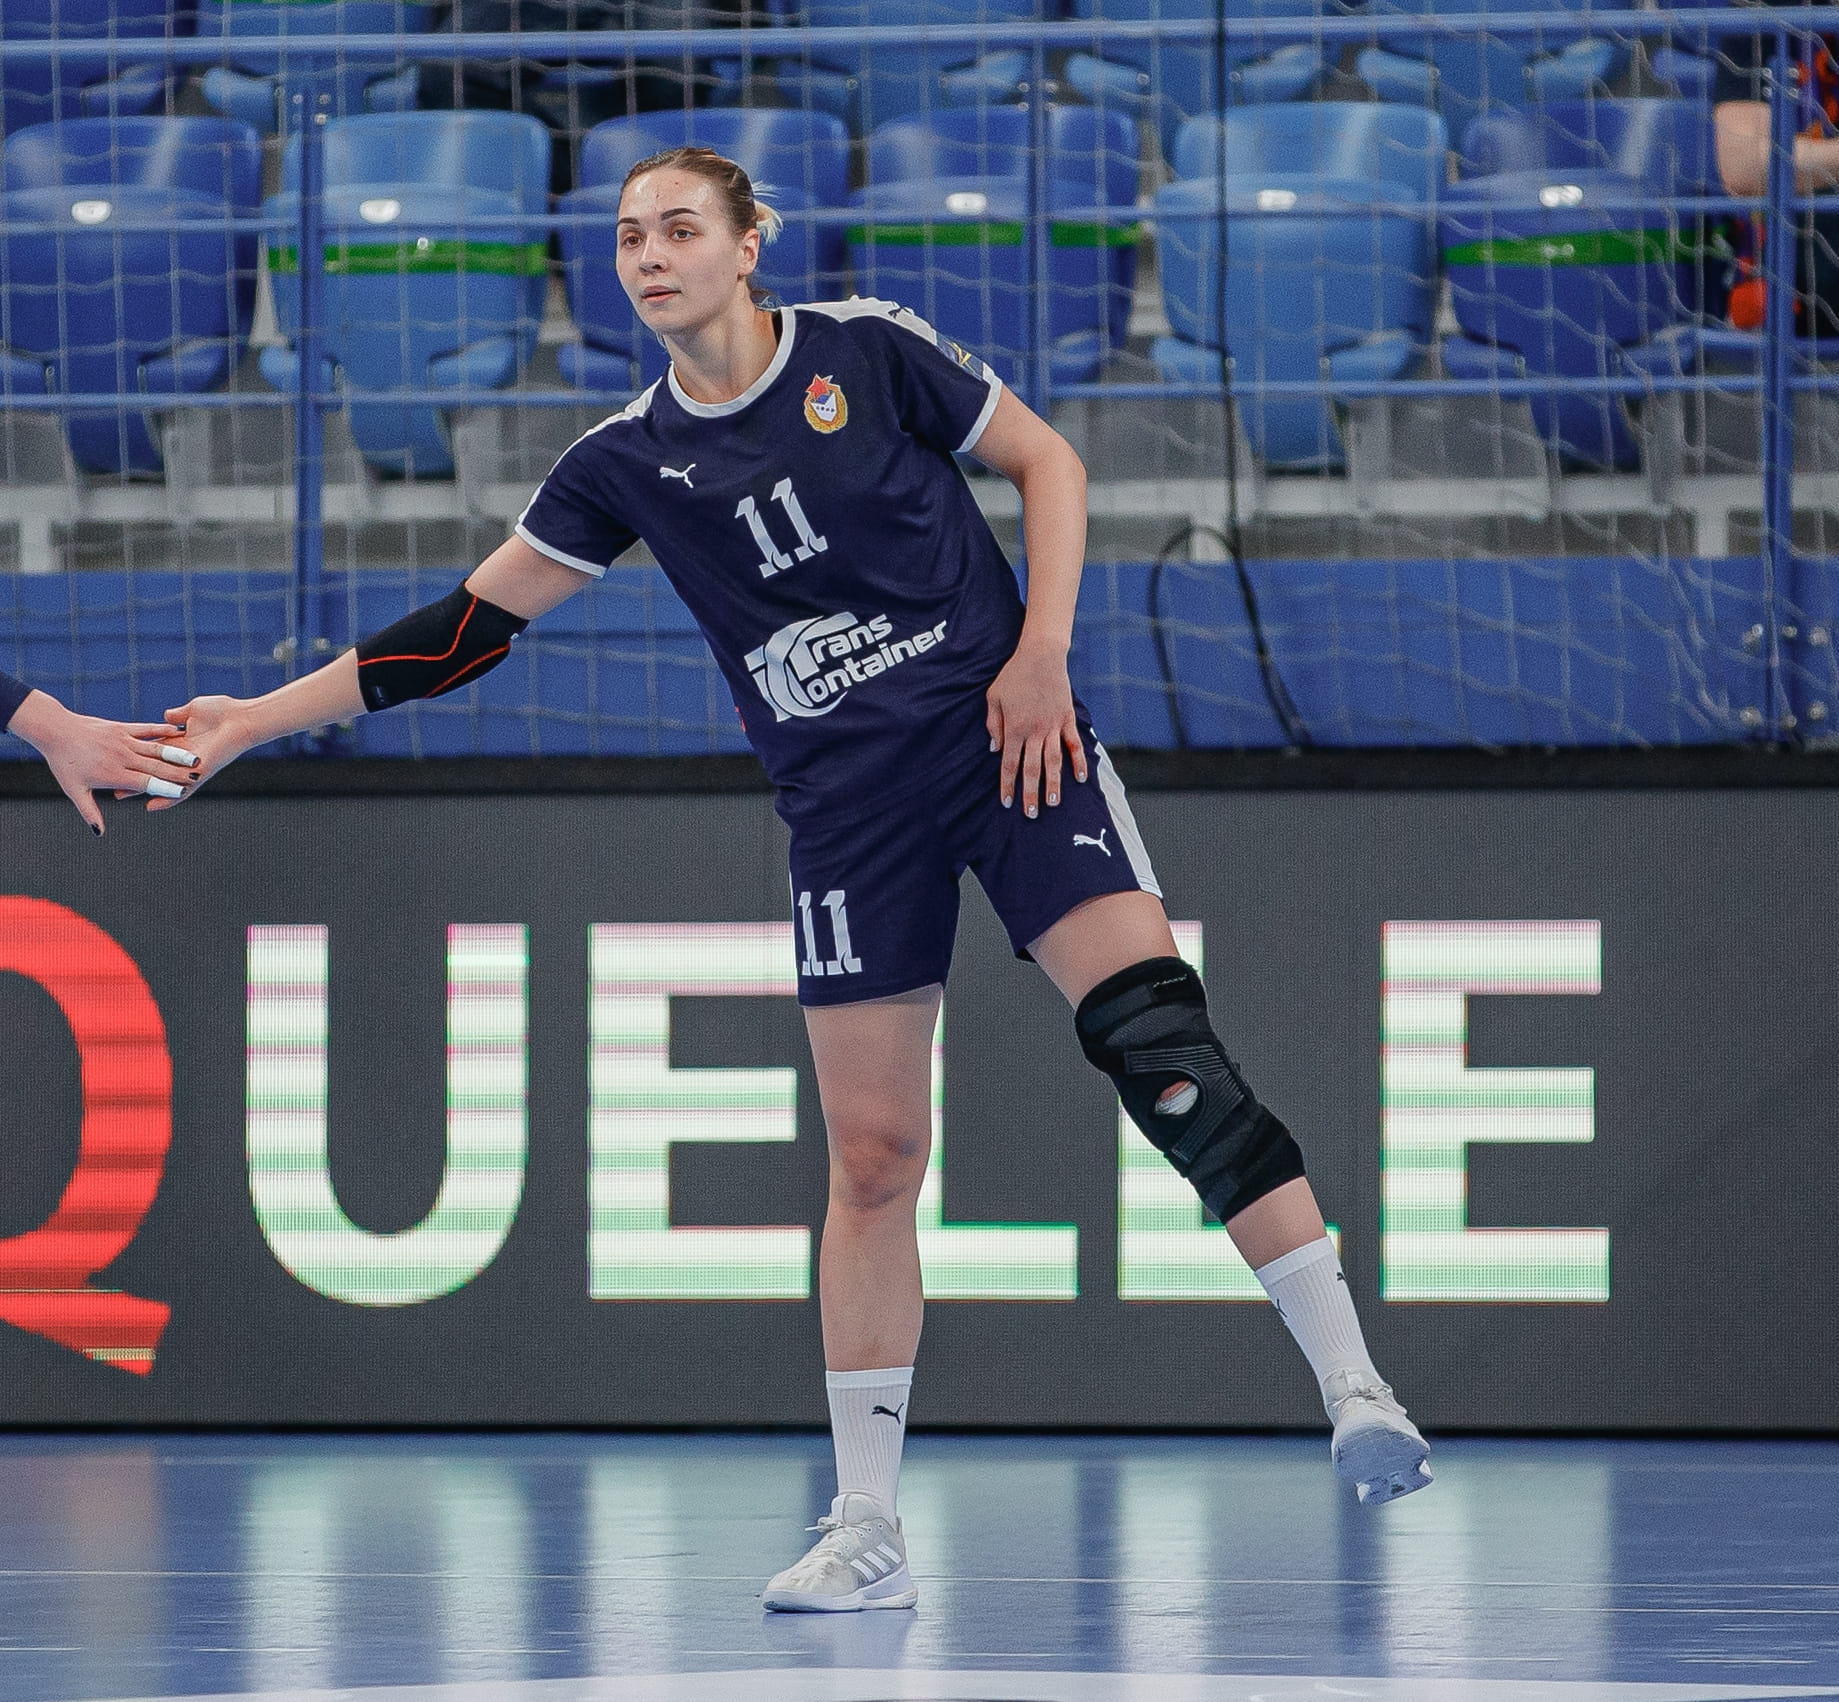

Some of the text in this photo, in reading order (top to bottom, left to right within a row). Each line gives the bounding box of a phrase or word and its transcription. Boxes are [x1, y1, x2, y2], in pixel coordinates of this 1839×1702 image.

[734, 477, 829, 578] 11
[789, 611, 893, 681] Trans
[798, 890, 863, 976] 11
